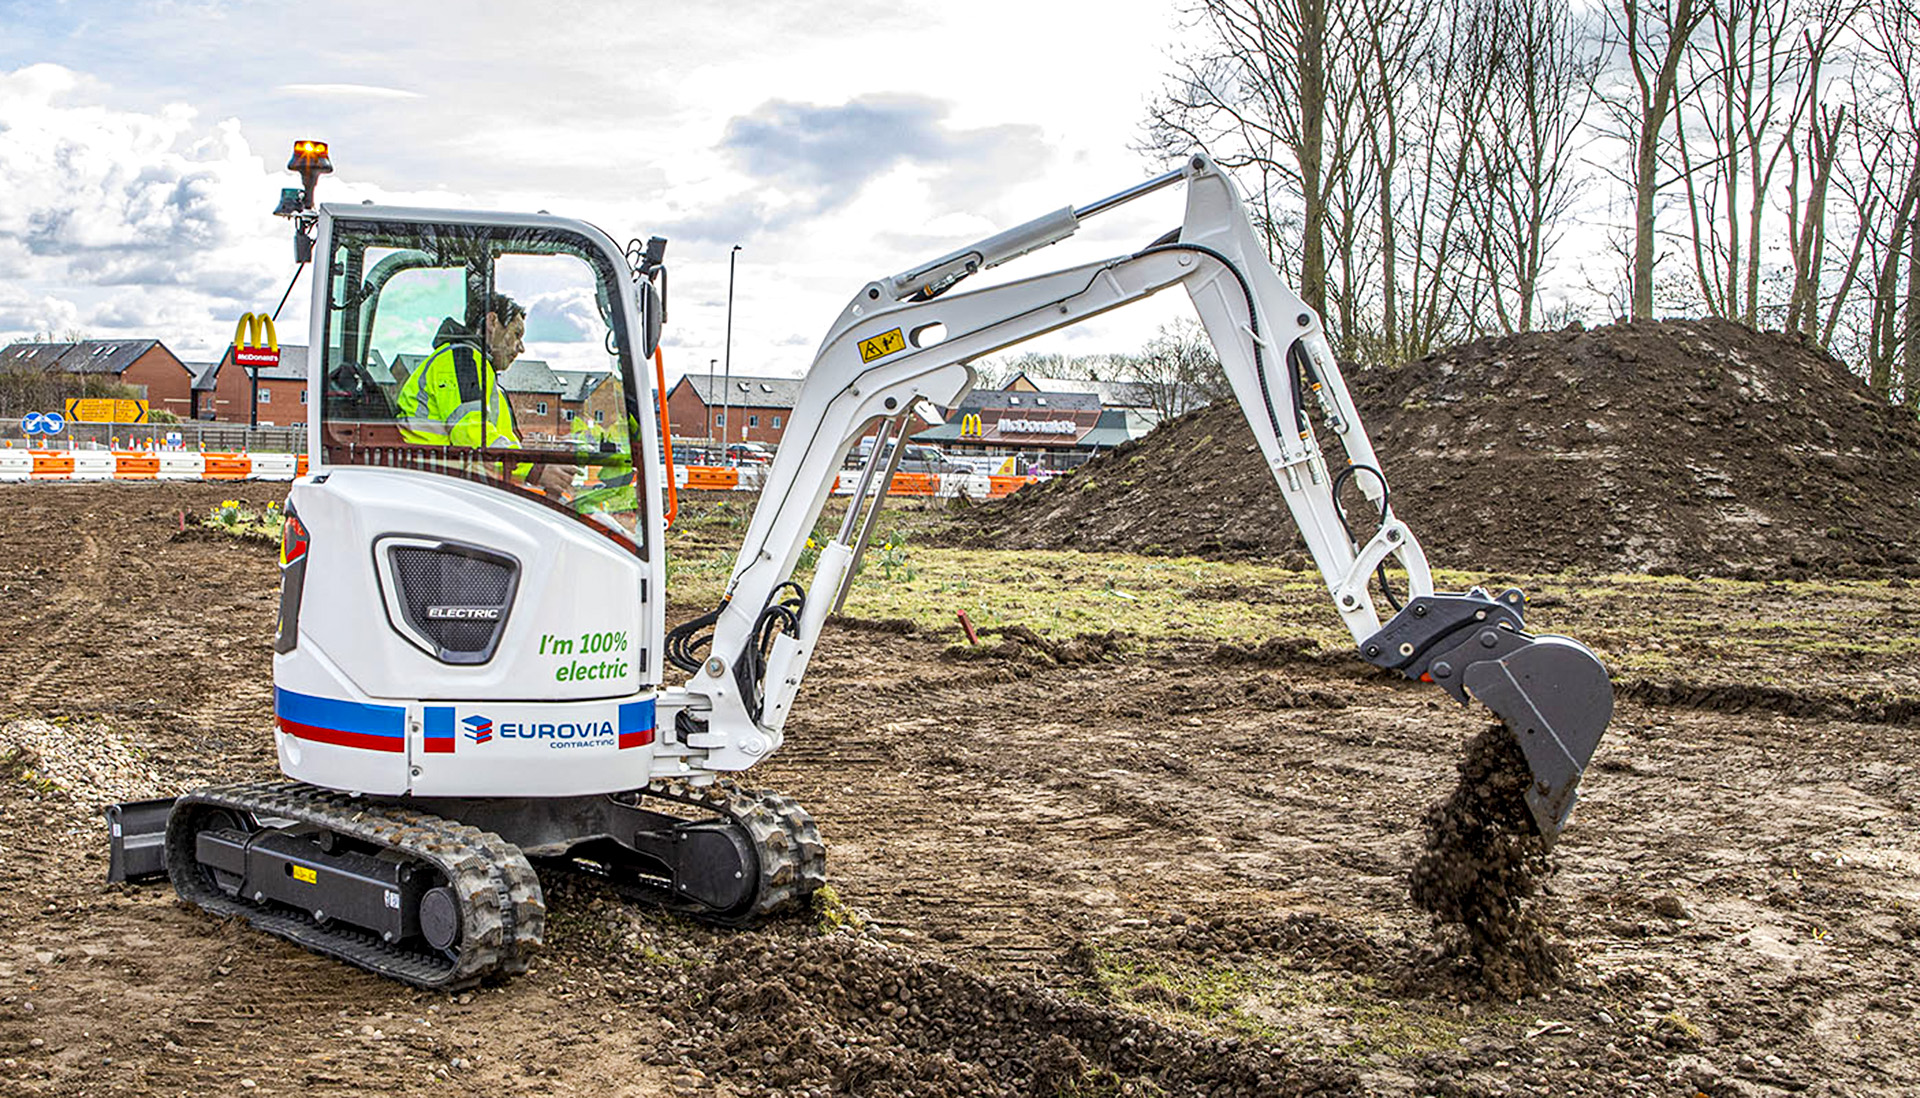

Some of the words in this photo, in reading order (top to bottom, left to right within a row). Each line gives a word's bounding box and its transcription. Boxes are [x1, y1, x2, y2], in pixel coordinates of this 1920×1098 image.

[237, 353, 279, 362] McDonald's
[997, 418, 1077, 434] McDonald's
[428, 608, 499, 618] ELECTRIC
[539, 634, 573, 655] I'm
[579, 631, 628, 654] 100%
[556, 658, 628, 682] electric
[500, 721, 614, 739] EUROVIA
[549, 739, 615, 749] CONTRACTING
